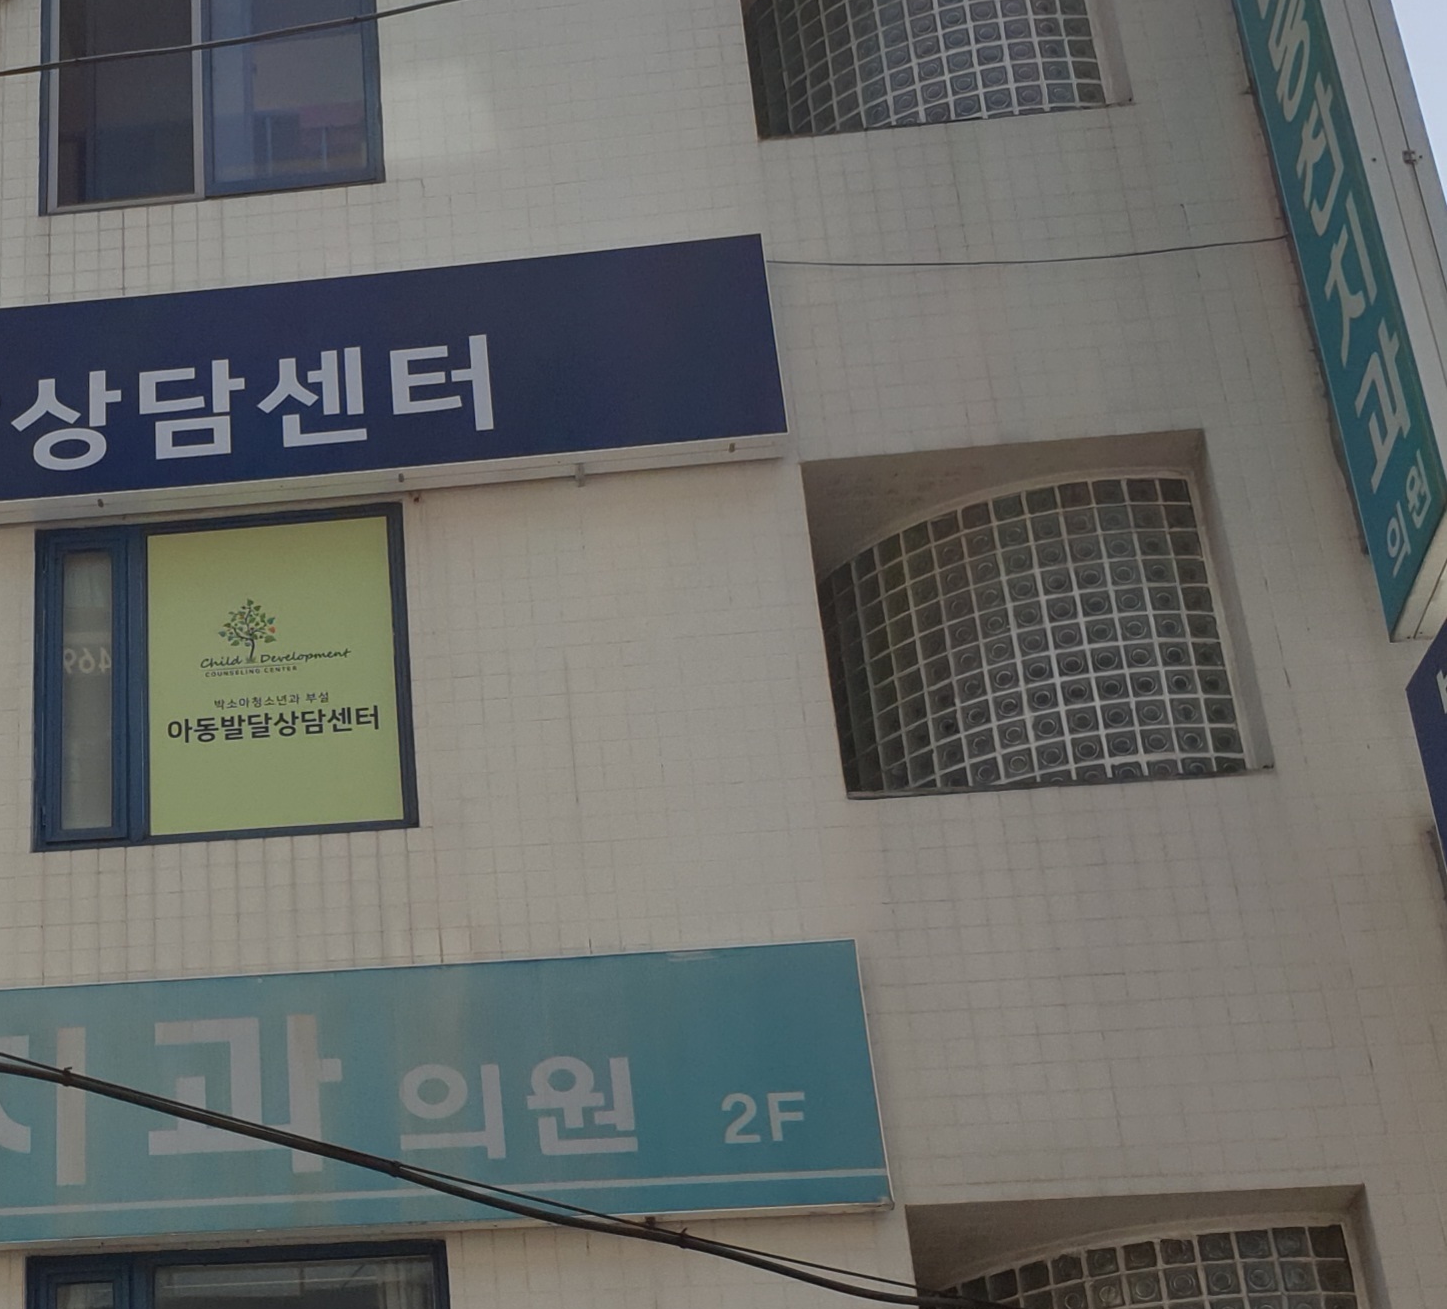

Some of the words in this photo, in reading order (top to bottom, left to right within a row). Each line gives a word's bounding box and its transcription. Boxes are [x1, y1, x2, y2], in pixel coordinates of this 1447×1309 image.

[200, 655, 243, 669] Child
[260, 647, 352, 664] Development
[205, 667, 261, 678] COUNSELING
[263, 665, 298, 674] CENTER
[214, 694, 300, 710] 박소아청소년과
[305, 692, 330, 704] 부설
[167, 705, 380, 744] 아동발달상담센터
[398, 1055, 638, 1160] 의원
[720, 1091, 806, 1145] 2F
